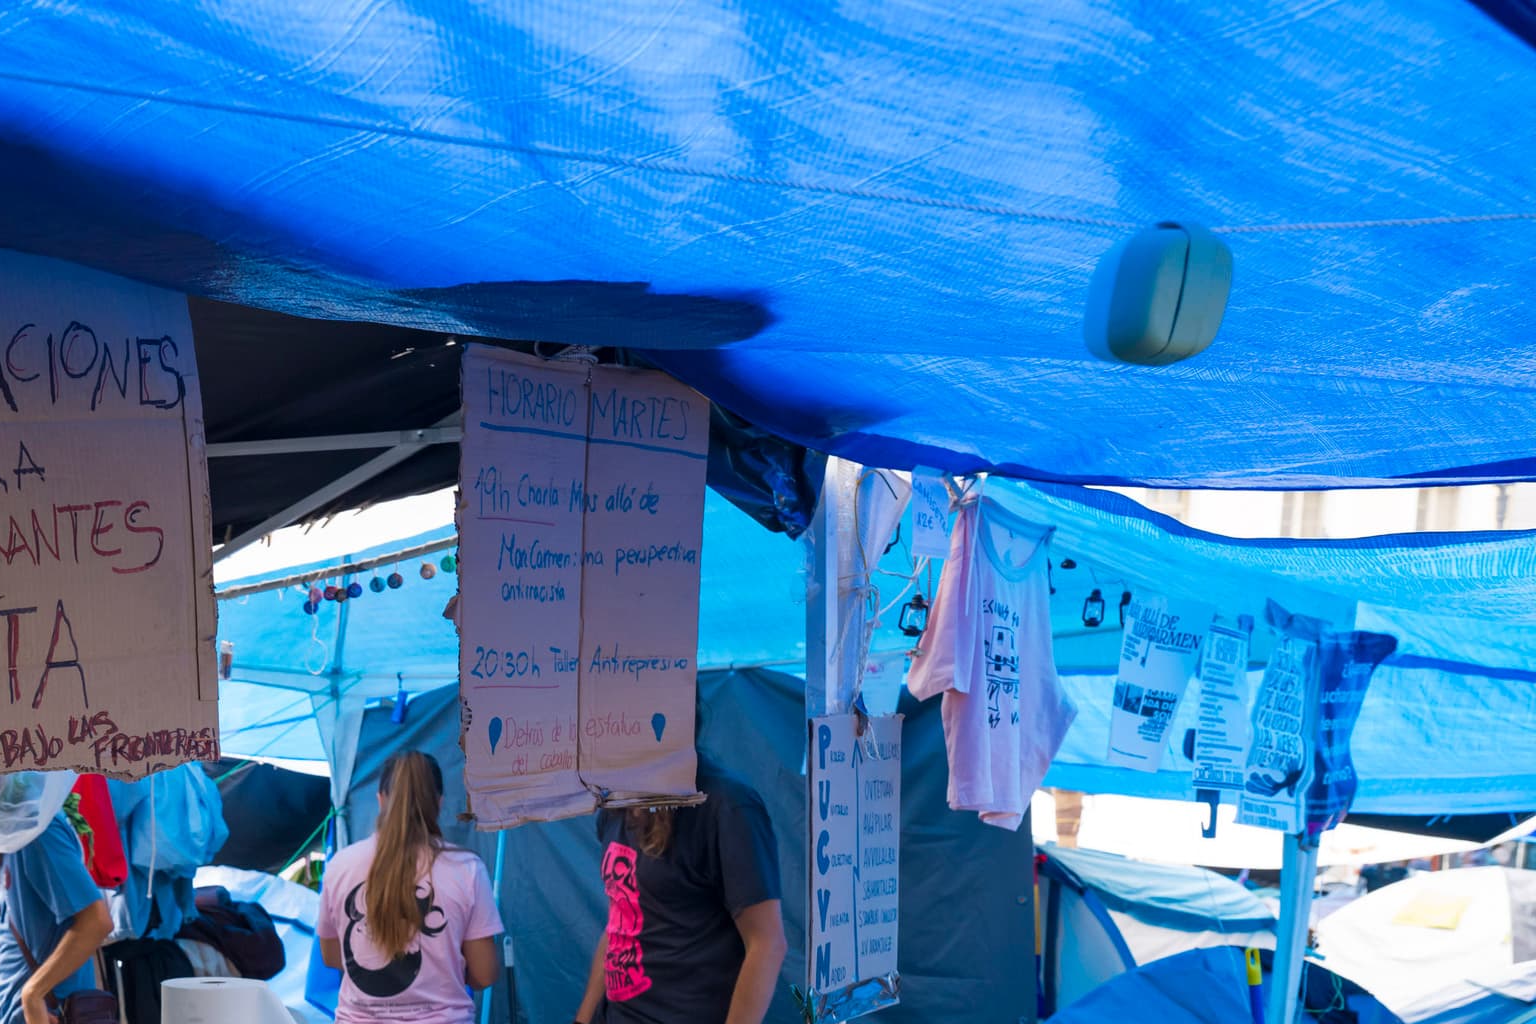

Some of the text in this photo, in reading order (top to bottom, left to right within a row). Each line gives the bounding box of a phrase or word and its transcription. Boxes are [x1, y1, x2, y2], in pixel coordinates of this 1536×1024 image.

[487, 368, 689, 441] HORARIO MARTES
[518, 474, 560, 506] Charla
[67, 711, 119, 744] LAS
